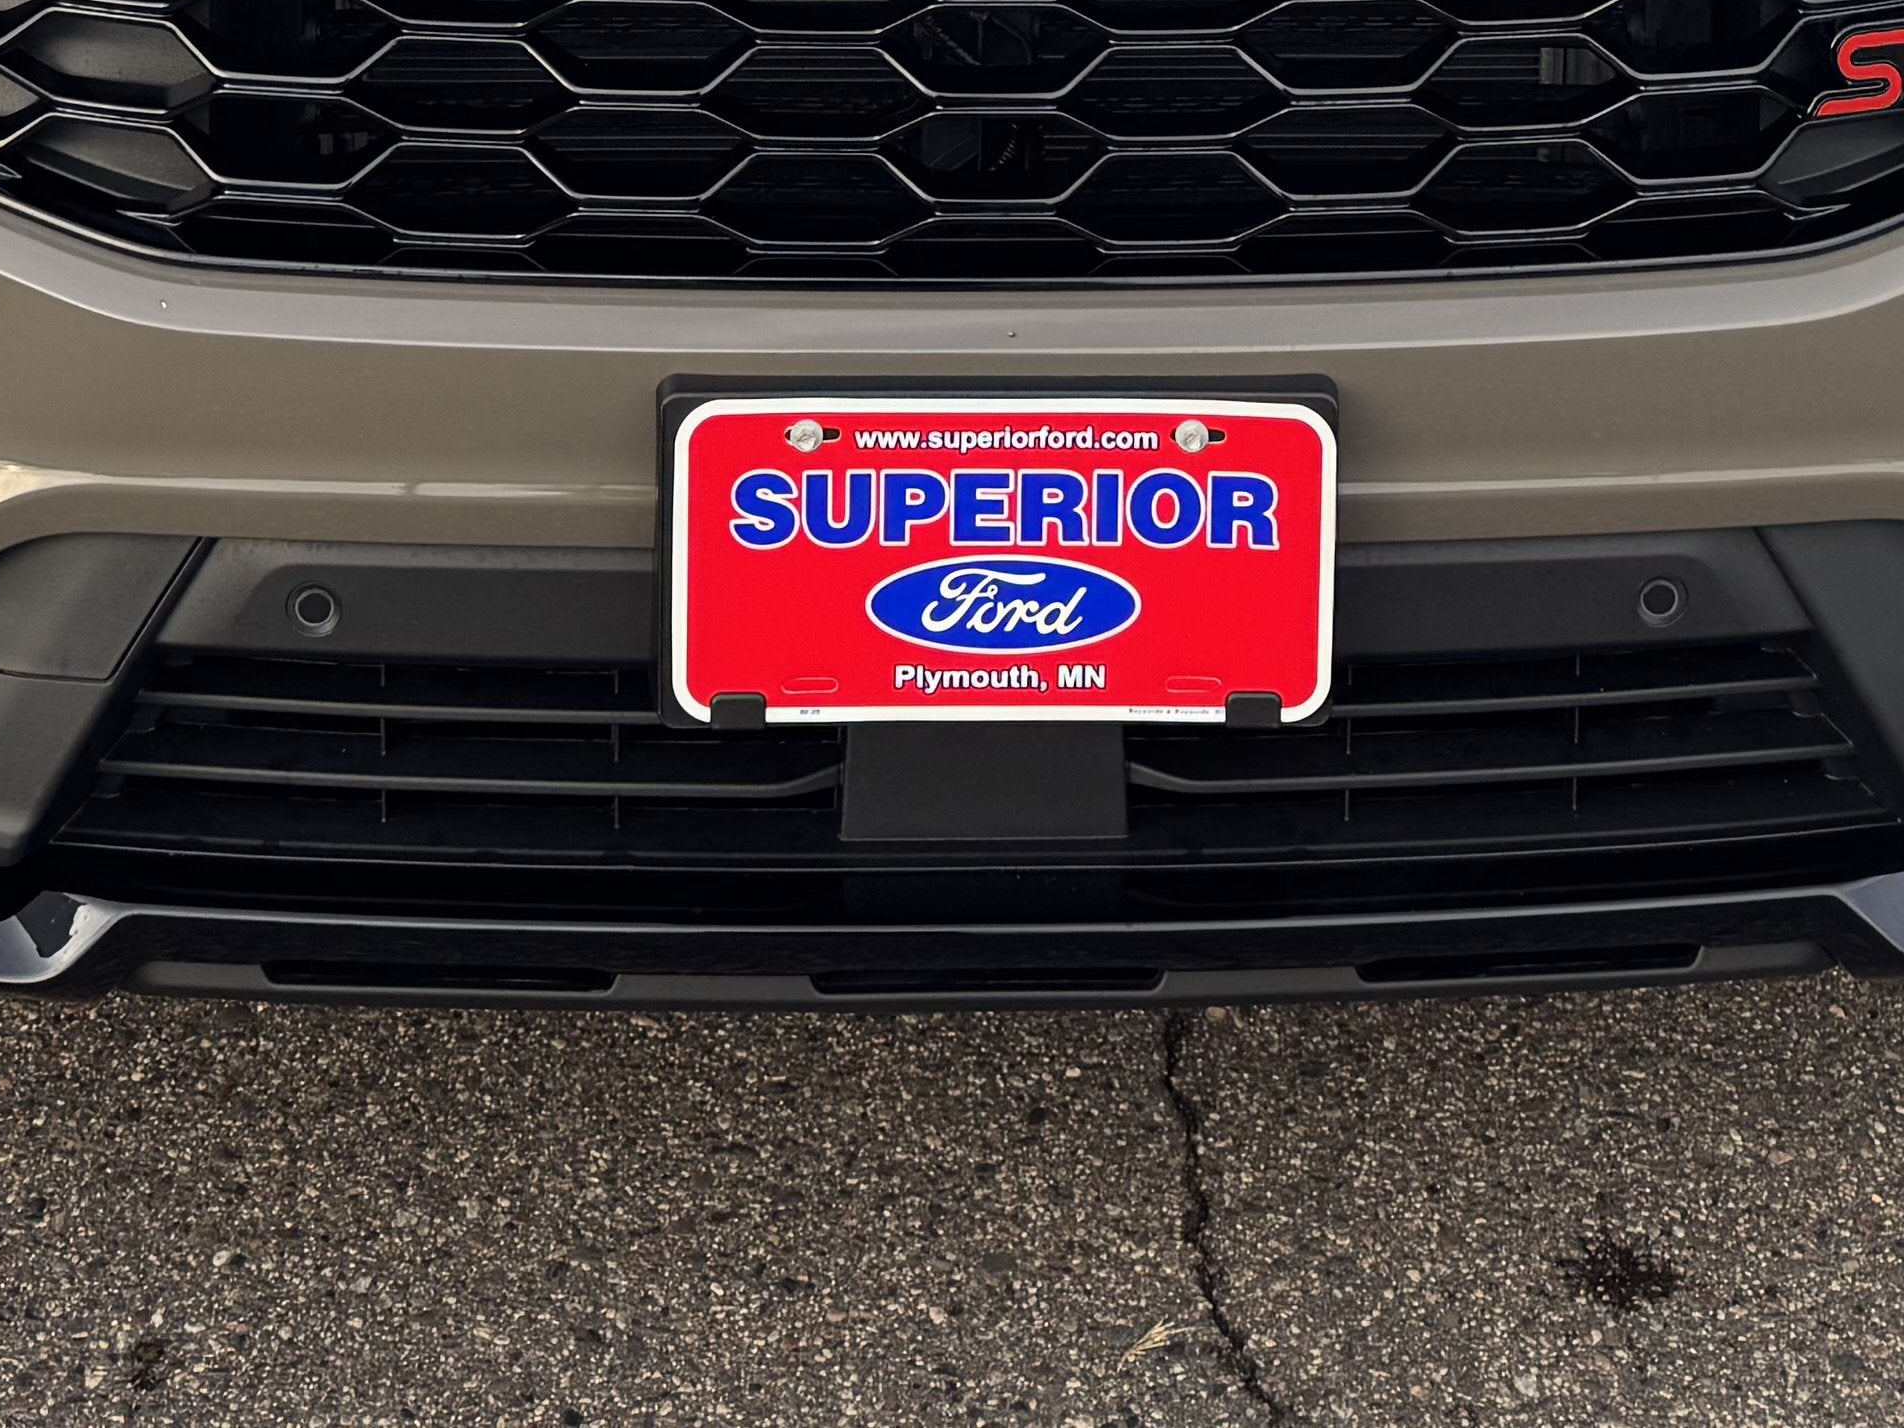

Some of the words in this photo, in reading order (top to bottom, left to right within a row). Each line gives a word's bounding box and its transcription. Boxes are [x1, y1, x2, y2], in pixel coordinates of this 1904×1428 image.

[854, 425, 1159, 453] www.superiorford.com
[730, 468, 1280, 550] SUPERIOR
[921, 567, 1084, 636] Ford
[894, 664, 1048, 693] Plymouth,
[1057, 665, 1107, 690] MN
